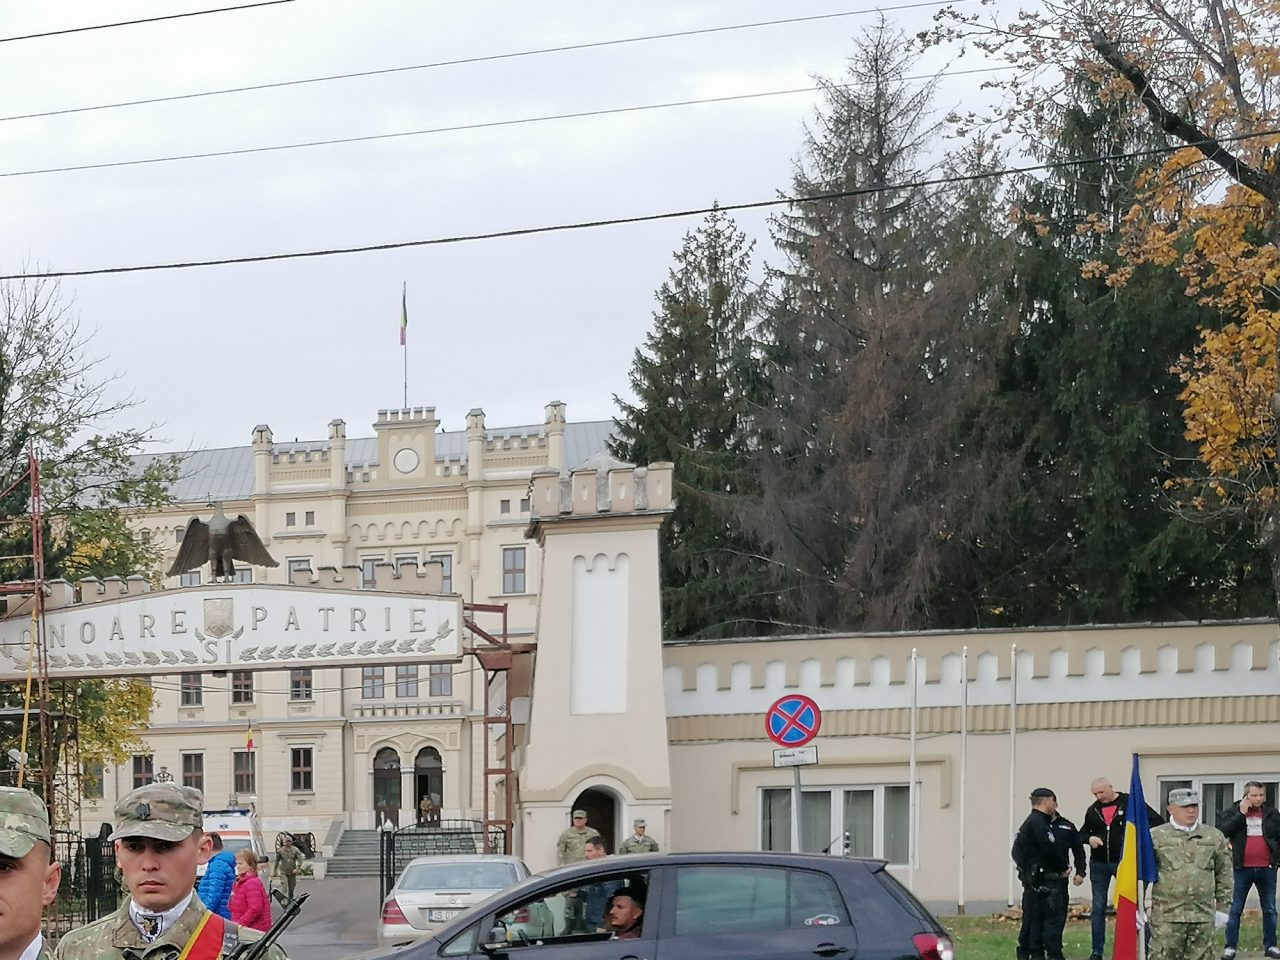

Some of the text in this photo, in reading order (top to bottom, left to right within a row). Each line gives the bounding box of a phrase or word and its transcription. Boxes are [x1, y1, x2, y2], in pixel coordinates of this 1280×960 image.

[21, 605, 427, 652] ONOARE PATRIE
[201, 639, 232, 665] SI
